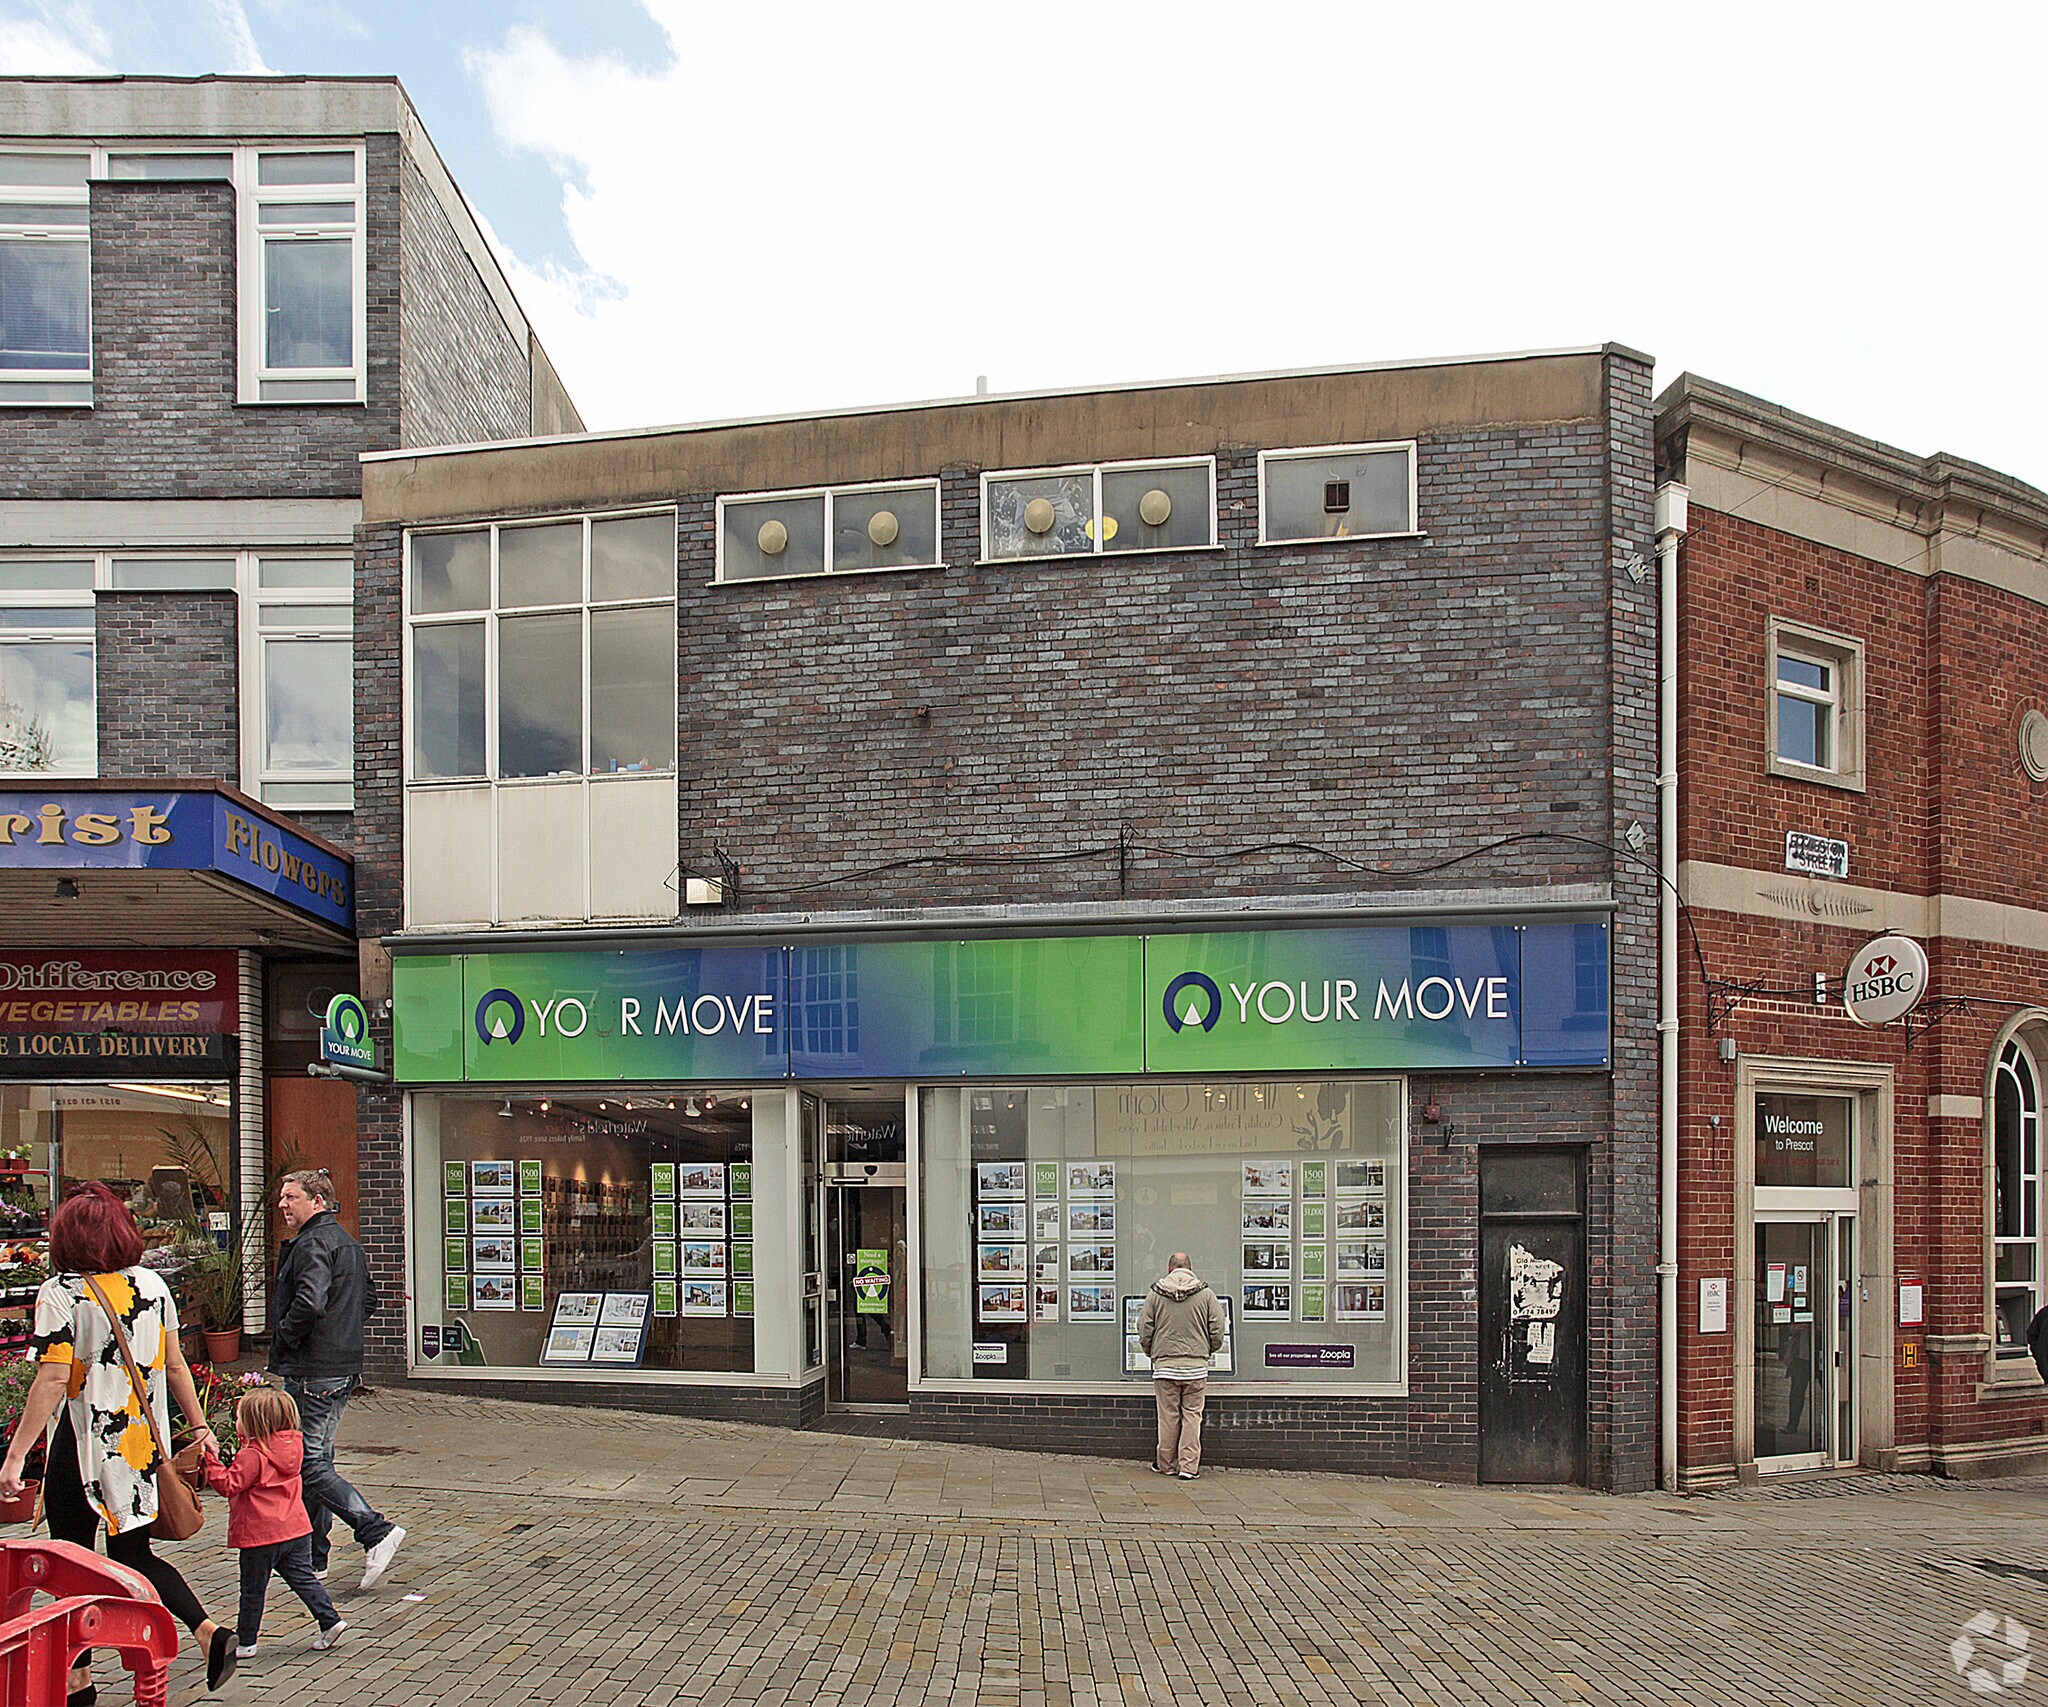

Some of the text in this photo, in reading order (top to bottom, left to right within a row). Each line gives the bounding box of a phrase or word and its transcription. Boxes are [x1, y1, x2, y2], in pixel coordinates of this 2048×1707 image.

[224, 810, 346, 906] Flowers
[1851, 971, 1914, 1003] HSBC
[1228, 975, 1508, 1025] YOUR MOVE
[654, 993, 774, 1036] MOVE
[18, 1034, 91, 1056] LOCAL
[99, 1036, 210, 1056] DELIVERY
[327, 1041, 372, 1061] YOUR MOVE
[1764, 1115, 1824, 1135] Welcome
[1775, 1138, 1814, 1151] to Prescot
[447, 1169, 463, 1178] 1500
[522, 1169, 538, 1177] 1500
[655, 1172, 671, 1180] 1500
[733, 1171, 750, 1180] 1500
[1037, 1171, 1056, 1180] 1500
[1304, 1170, 1323, 1179] 1500
[1303, 1250, 1324, 1261] easy
[864, 1276, 889, 1284] WAITING
[1320, 1349, 1351, 1361] Zoopla
